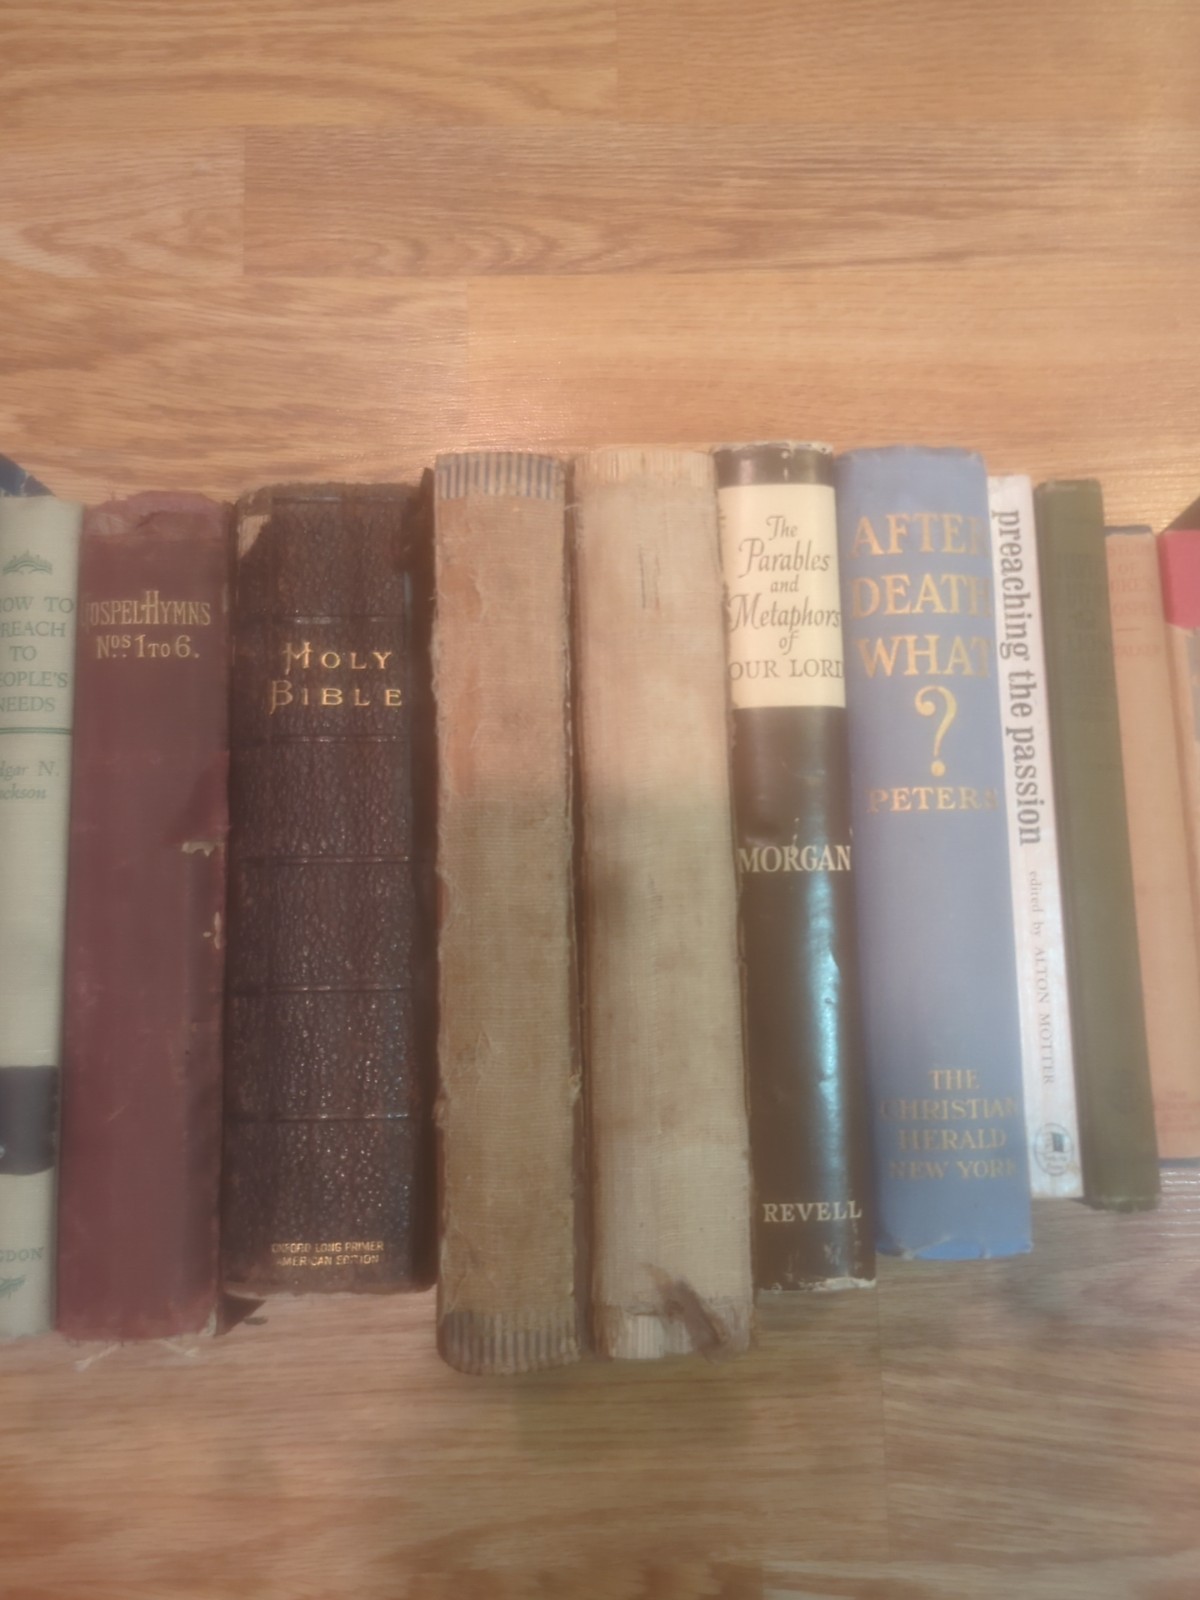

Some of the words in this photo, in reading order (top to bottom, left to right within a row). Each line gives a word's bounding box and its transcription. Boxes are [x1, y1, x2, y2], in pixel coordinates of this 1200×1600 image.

[766, 515, 798, 541] The
[850, 513, 989, 556] AFTER
[738, 538, 831, 579] Parables
[770, 574, 799, 593] and
[851, 573, 993, 619] DEATH
[992, 511, 1032, 661] preaching
[0, 596, 34, 613] OW
[44, 596, 74, 614] TO
[728, 593, 842, 633] Metaphors
[0, 621, 67, 639] REACH
[778, 630, 799, 656] of
[9, 646, 37, 662] TO
[855, 634, 992, 678] WHAT
[728, 660, 779, 681] OUR
[270, 681, 402, 715] BIBLE
[1008, 669, 1036, 718] the
[914, 685, 957, 777] ?
[1006, 726, 1045, 845] passion
[738, 845, 851, 874] MORGAN
[1030, 870, 1044, 913] edited
[1030, 921, 1044, 936] by
[1034, 946, 1049, 1004] ALTON
[1040, 1013, 1054, 1085] MOTTER
[928, 1069, 981, 1091] THE
[898, 1127, 1008, 1151] HERALD
[888, 1160, 949, 1180] NEW
[763, 1201, 862, 1223] REVELL
